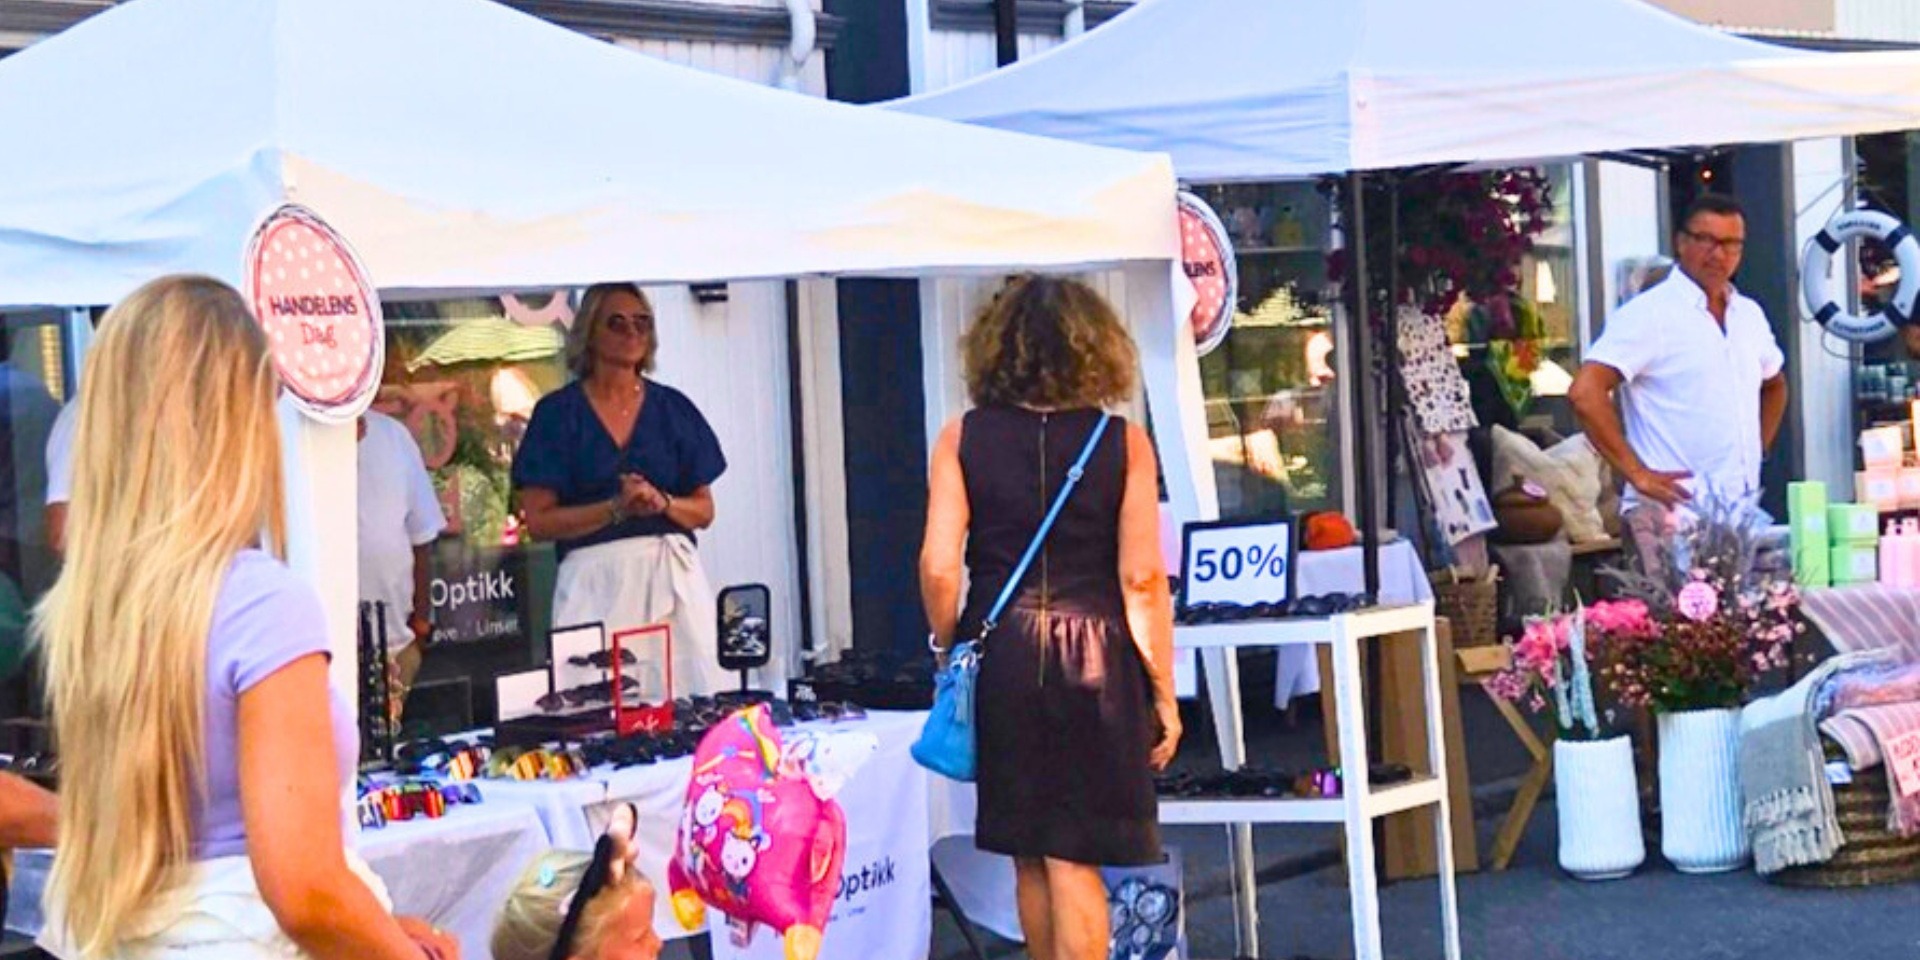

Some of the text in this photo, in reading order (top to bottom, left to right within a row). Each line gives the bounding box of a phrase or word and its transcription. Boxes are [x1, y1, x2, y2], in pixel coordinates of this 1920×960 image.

[269, 295, 358, 316] HANDELENS
[1194, 543, 1285, 583] 50%
[430, 569, 515, 610] Optikk
